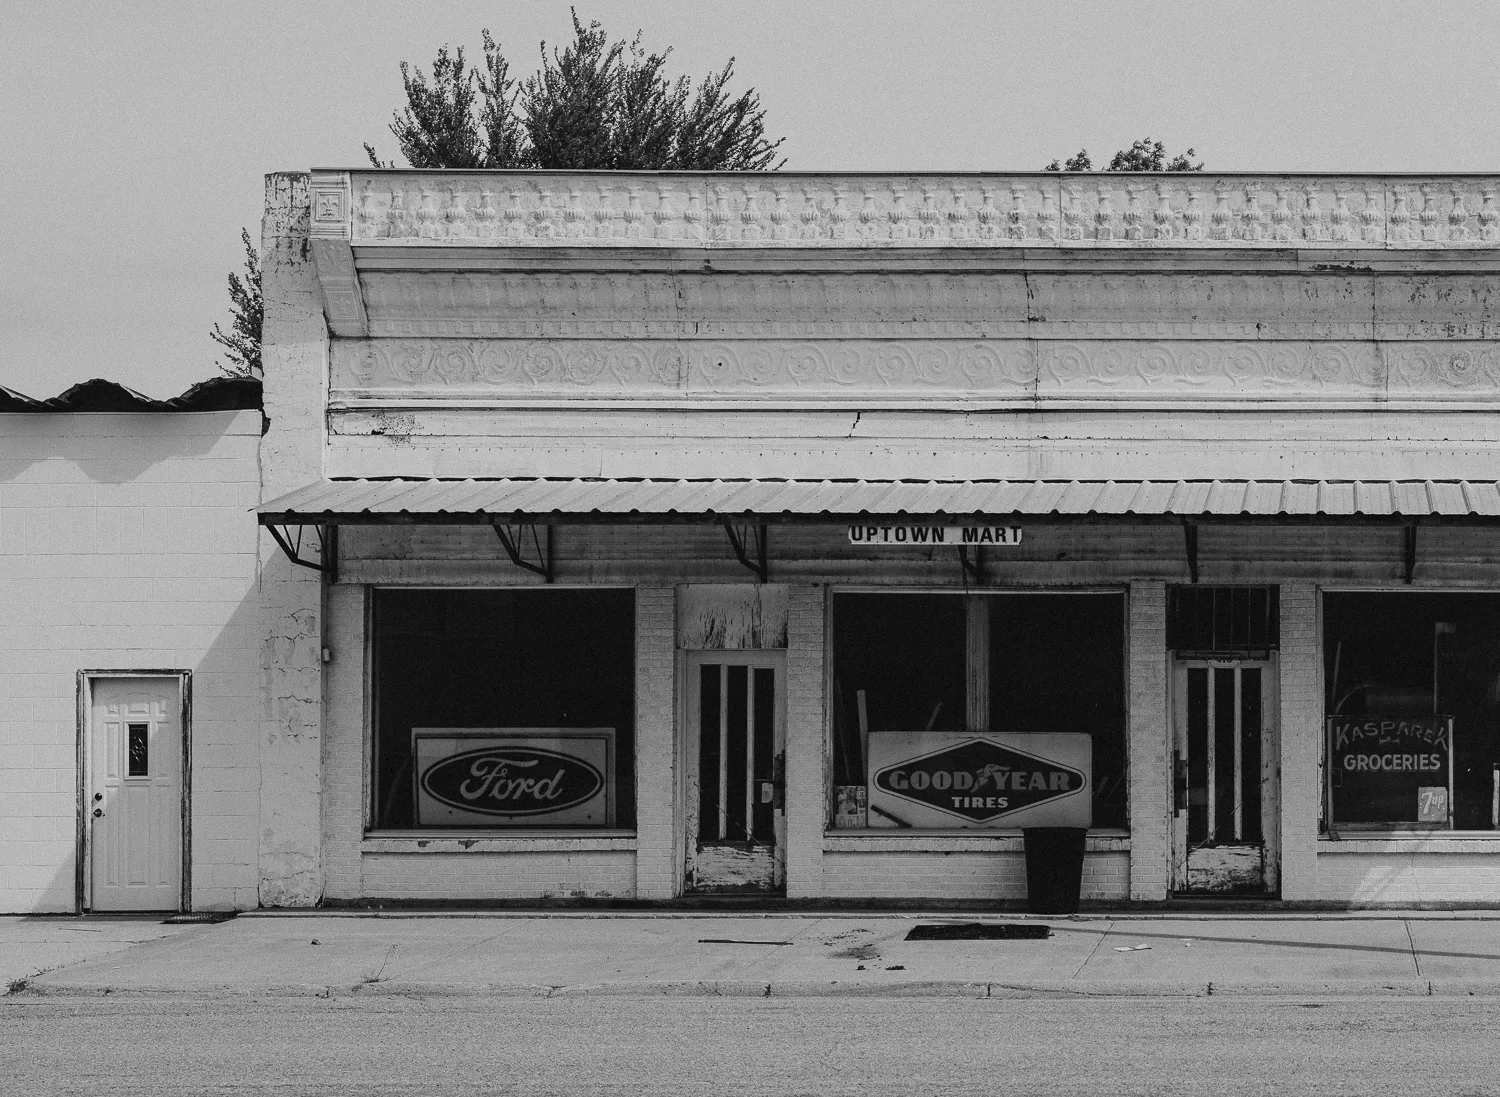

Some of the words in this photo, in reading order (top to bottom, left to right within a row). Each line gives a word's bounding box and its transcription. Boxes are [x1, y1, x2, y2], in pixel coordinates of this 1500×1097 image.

[851, 525, 944, 543] UPTOWN
[962, 526, 1022, 543] MART
[1336, 721, 1448, 751] KASPAREK
[1343, 754, 1441, 771] GROCERIES
[460, 757, 566, 800] Ford
[952, 797, 1009, 808] TIRES
